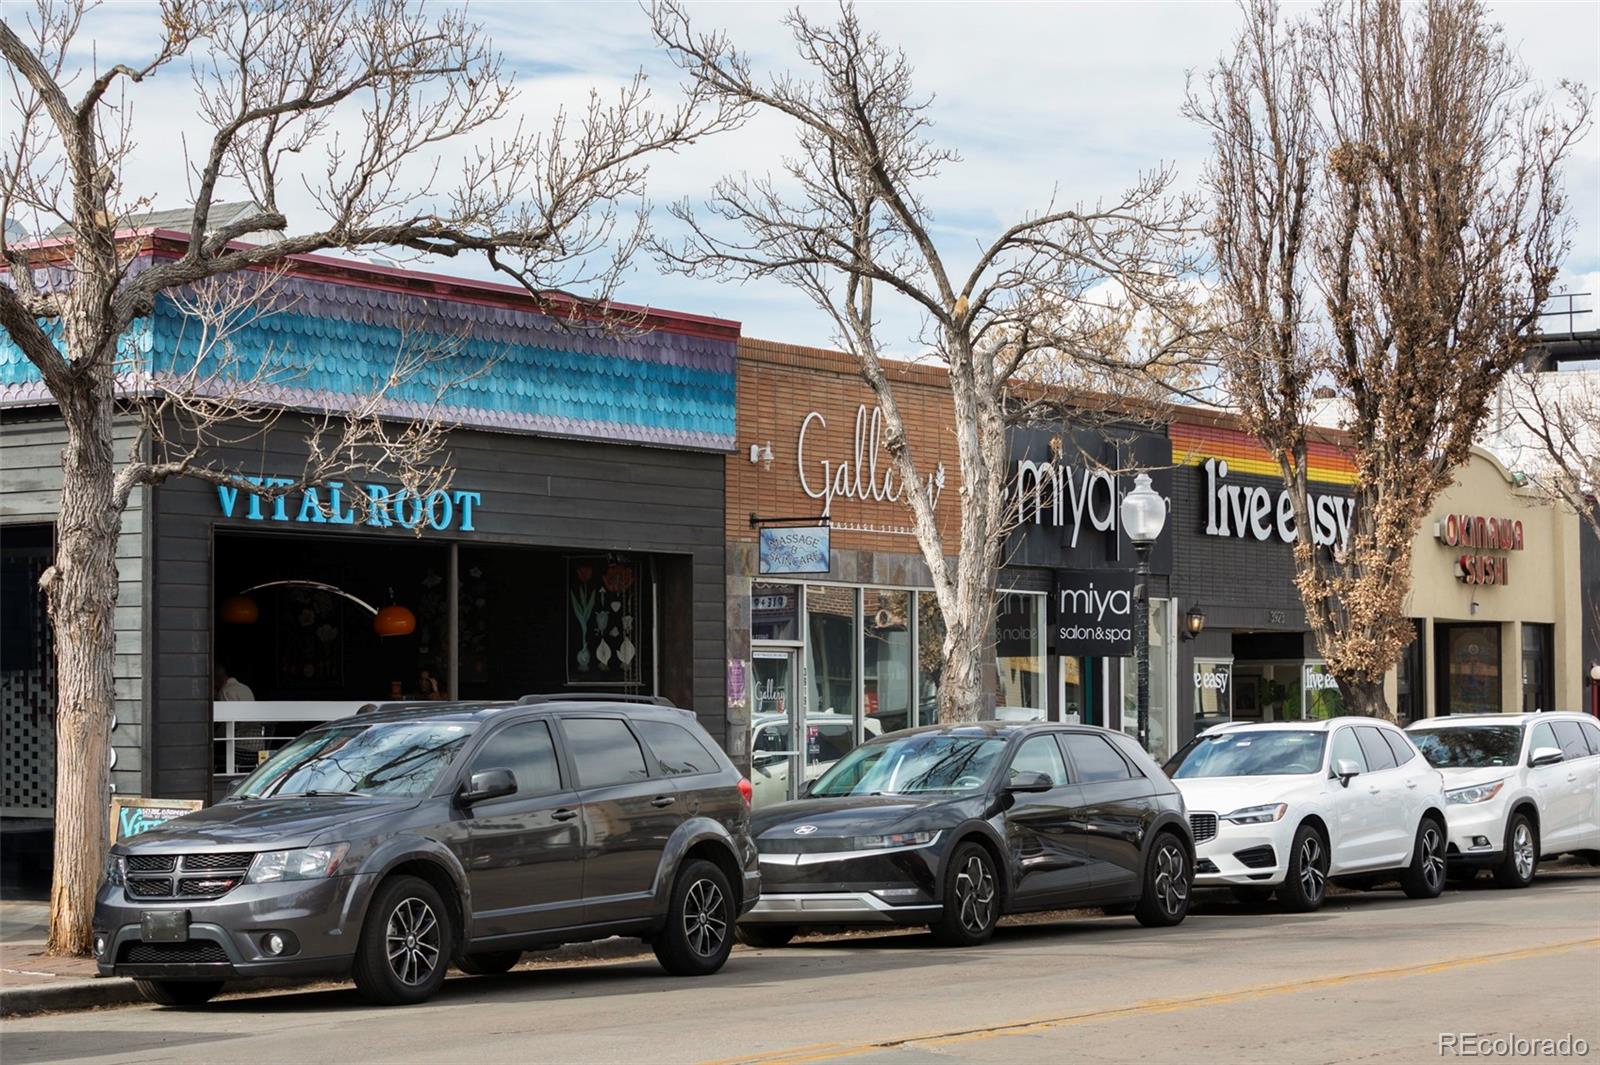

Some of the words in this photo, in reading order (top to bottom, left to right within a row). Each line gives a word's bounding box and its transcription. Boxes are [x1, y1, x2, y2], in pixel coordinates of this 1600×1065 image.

[798, 404, 945, 528] Galley
[217, 474, 354, 525] VITAL
[365, 484, 481, 532] ROOT
[1018, 448, 1116, 548] miya
[1205, 457, 1272, 541] live
[768, 533, 820, 551] MASSAGE
[1444, 513, 1524, 551] OKINAWA
[1461, 555, 1509, 586] SUSHI
[1061, 582, 1131, 622] miya
[755, 678, 785, 711] Gallery
[1203, 672, 1229, 693] easy
[1306, 667, 1324, 689] live
[1324, 673, 1340, 689] ea
